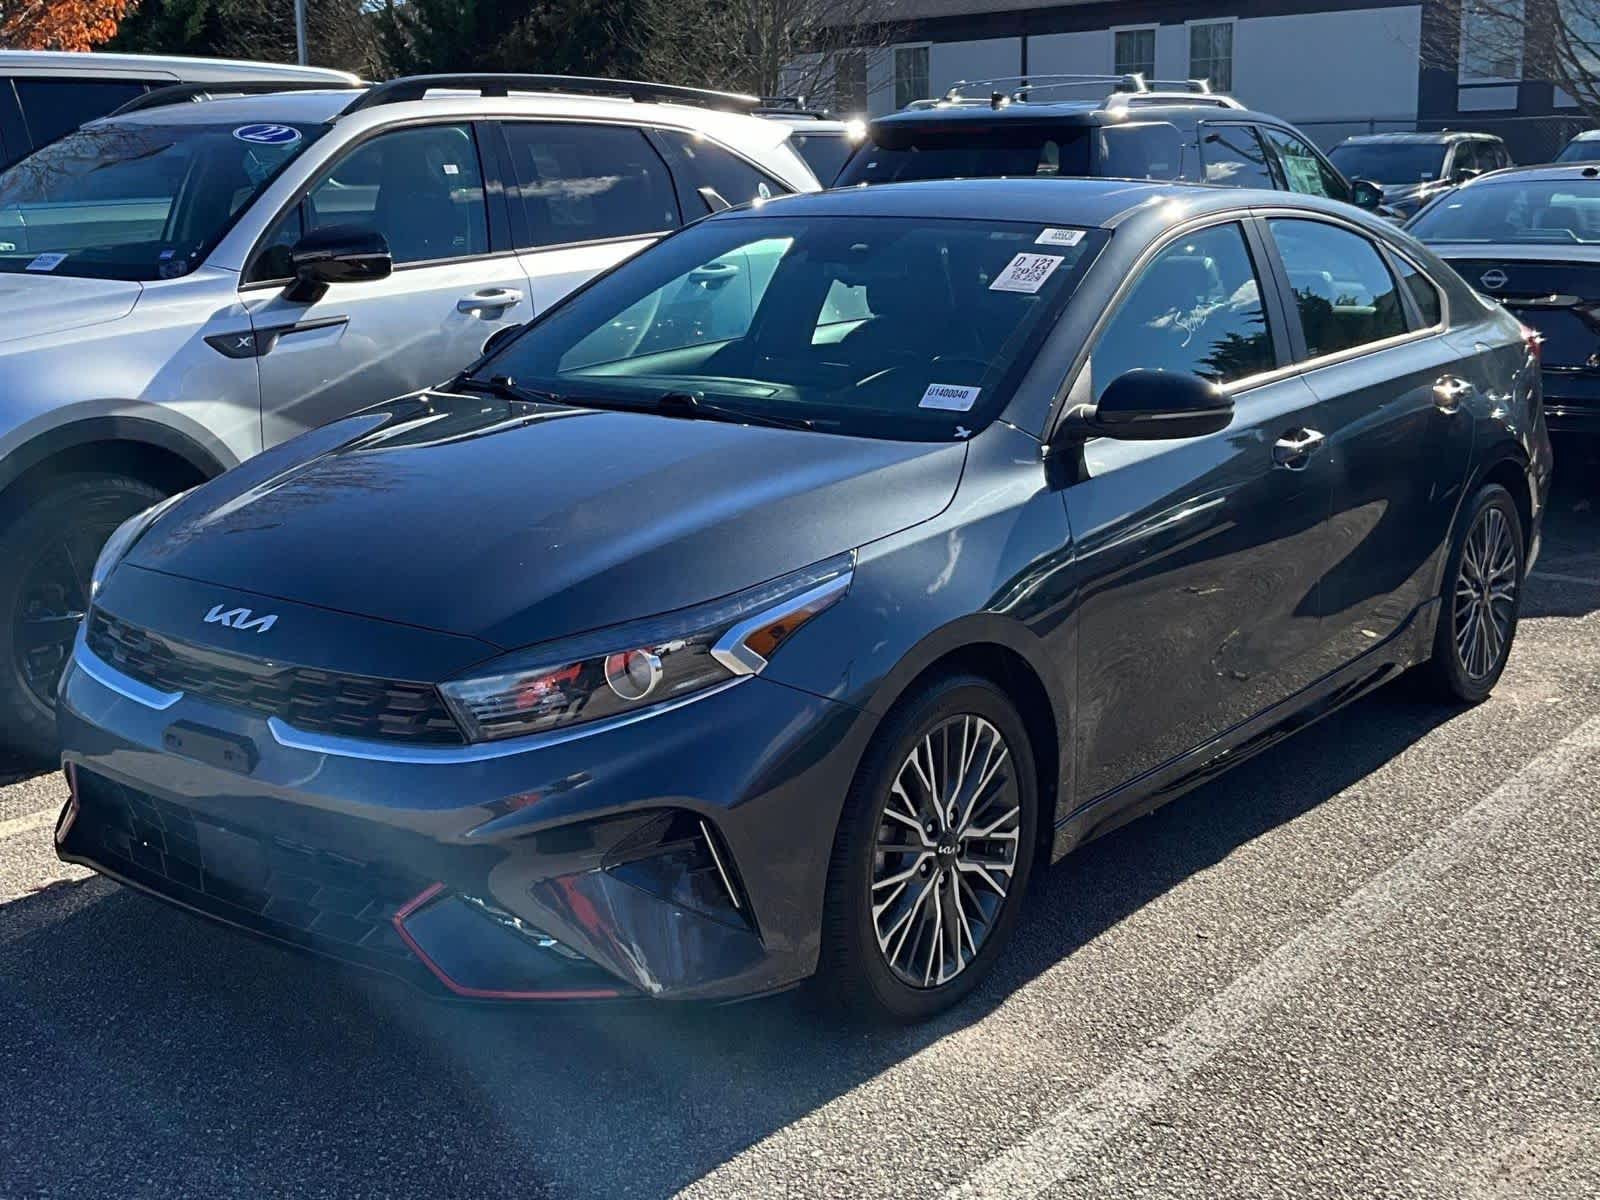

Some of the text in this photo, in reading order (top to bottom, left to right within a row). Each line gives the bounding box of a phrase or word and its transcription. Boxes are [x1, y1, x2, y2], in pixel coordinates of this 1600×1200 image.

[1014, 256, 1054, 270] D 123
[204, 603, 279, 633] KIA
